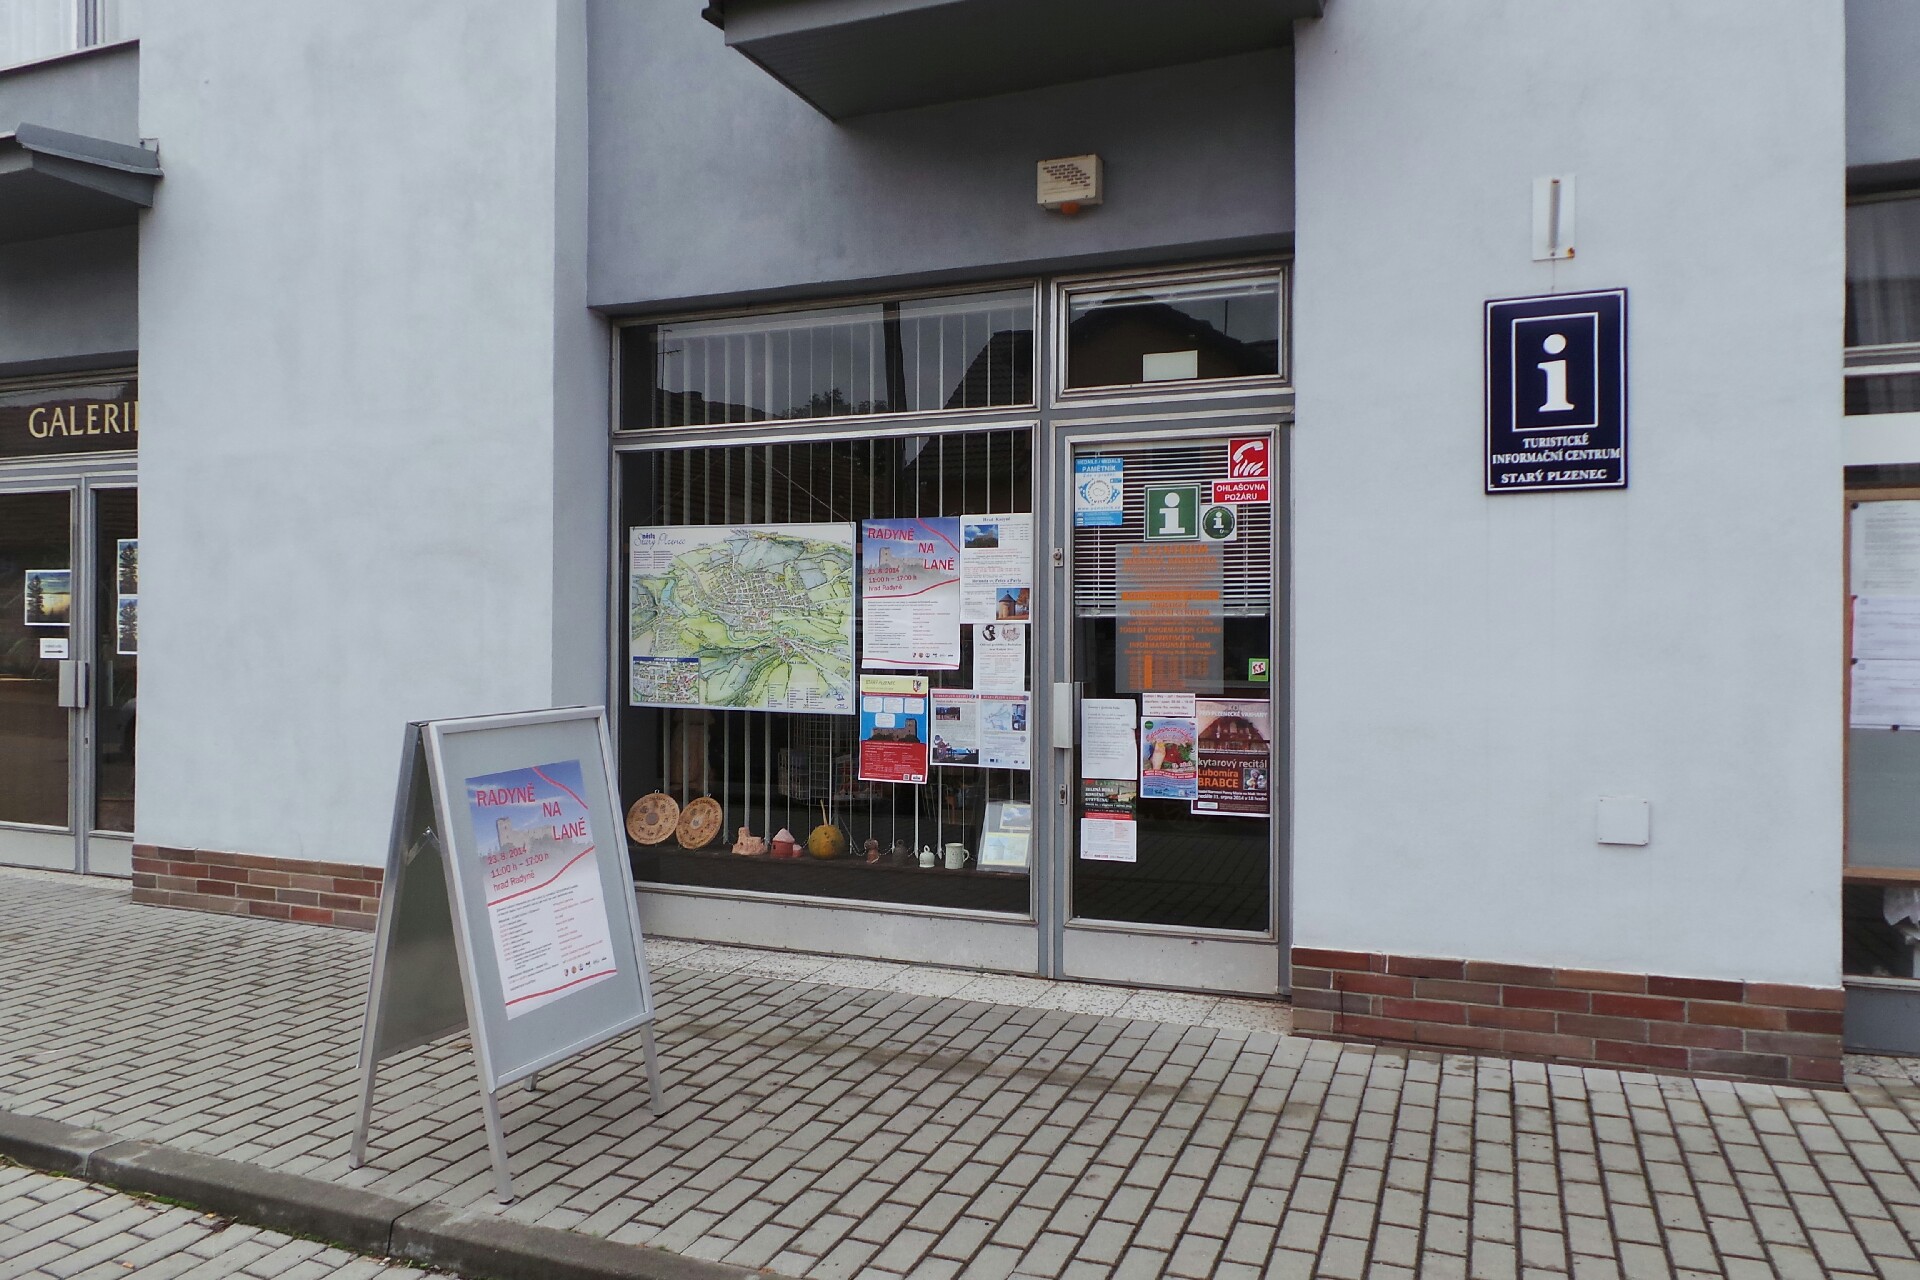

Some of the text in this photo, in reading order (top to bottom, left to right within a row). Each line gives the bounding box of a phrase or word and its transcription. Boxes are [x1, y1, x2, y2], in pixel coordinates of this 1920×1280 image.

[1522, 433, 1590, 449] TURISTICKÉ
[1492, 448, 1620, 464] INFORMAČNÍ CENTRUM
[1501, 469, 1607, 484] STARÝ PLZENEC
[1216, 483, 1266, 492] OHLAŠOVNA
[1224, 492, 1258, 501] POŽÁRU
[867, 527, 914, 541] RADYNĚ
[918, 542, 935, 554] NA
[923, 557, 955, 570] LANĚ
[1198, 757, 1267, 769] kytarový recitál
[1198, 768, 1239, 777] Lubomíra
[1198, 778, 1239, 788] BRABCE
[476, 782, 536, 807] RADYNĚ
[542, 801, 562, 817] NA
[552, 817, 587, 841] LANĚ
[487, 855, 500, 865] 23.
[509, 843, 527, 859] 2014
[490, 865, 511, 879] 11:00
[525, 853, 544, 867] 17:00
[493, 879, 509, 892] hrad
